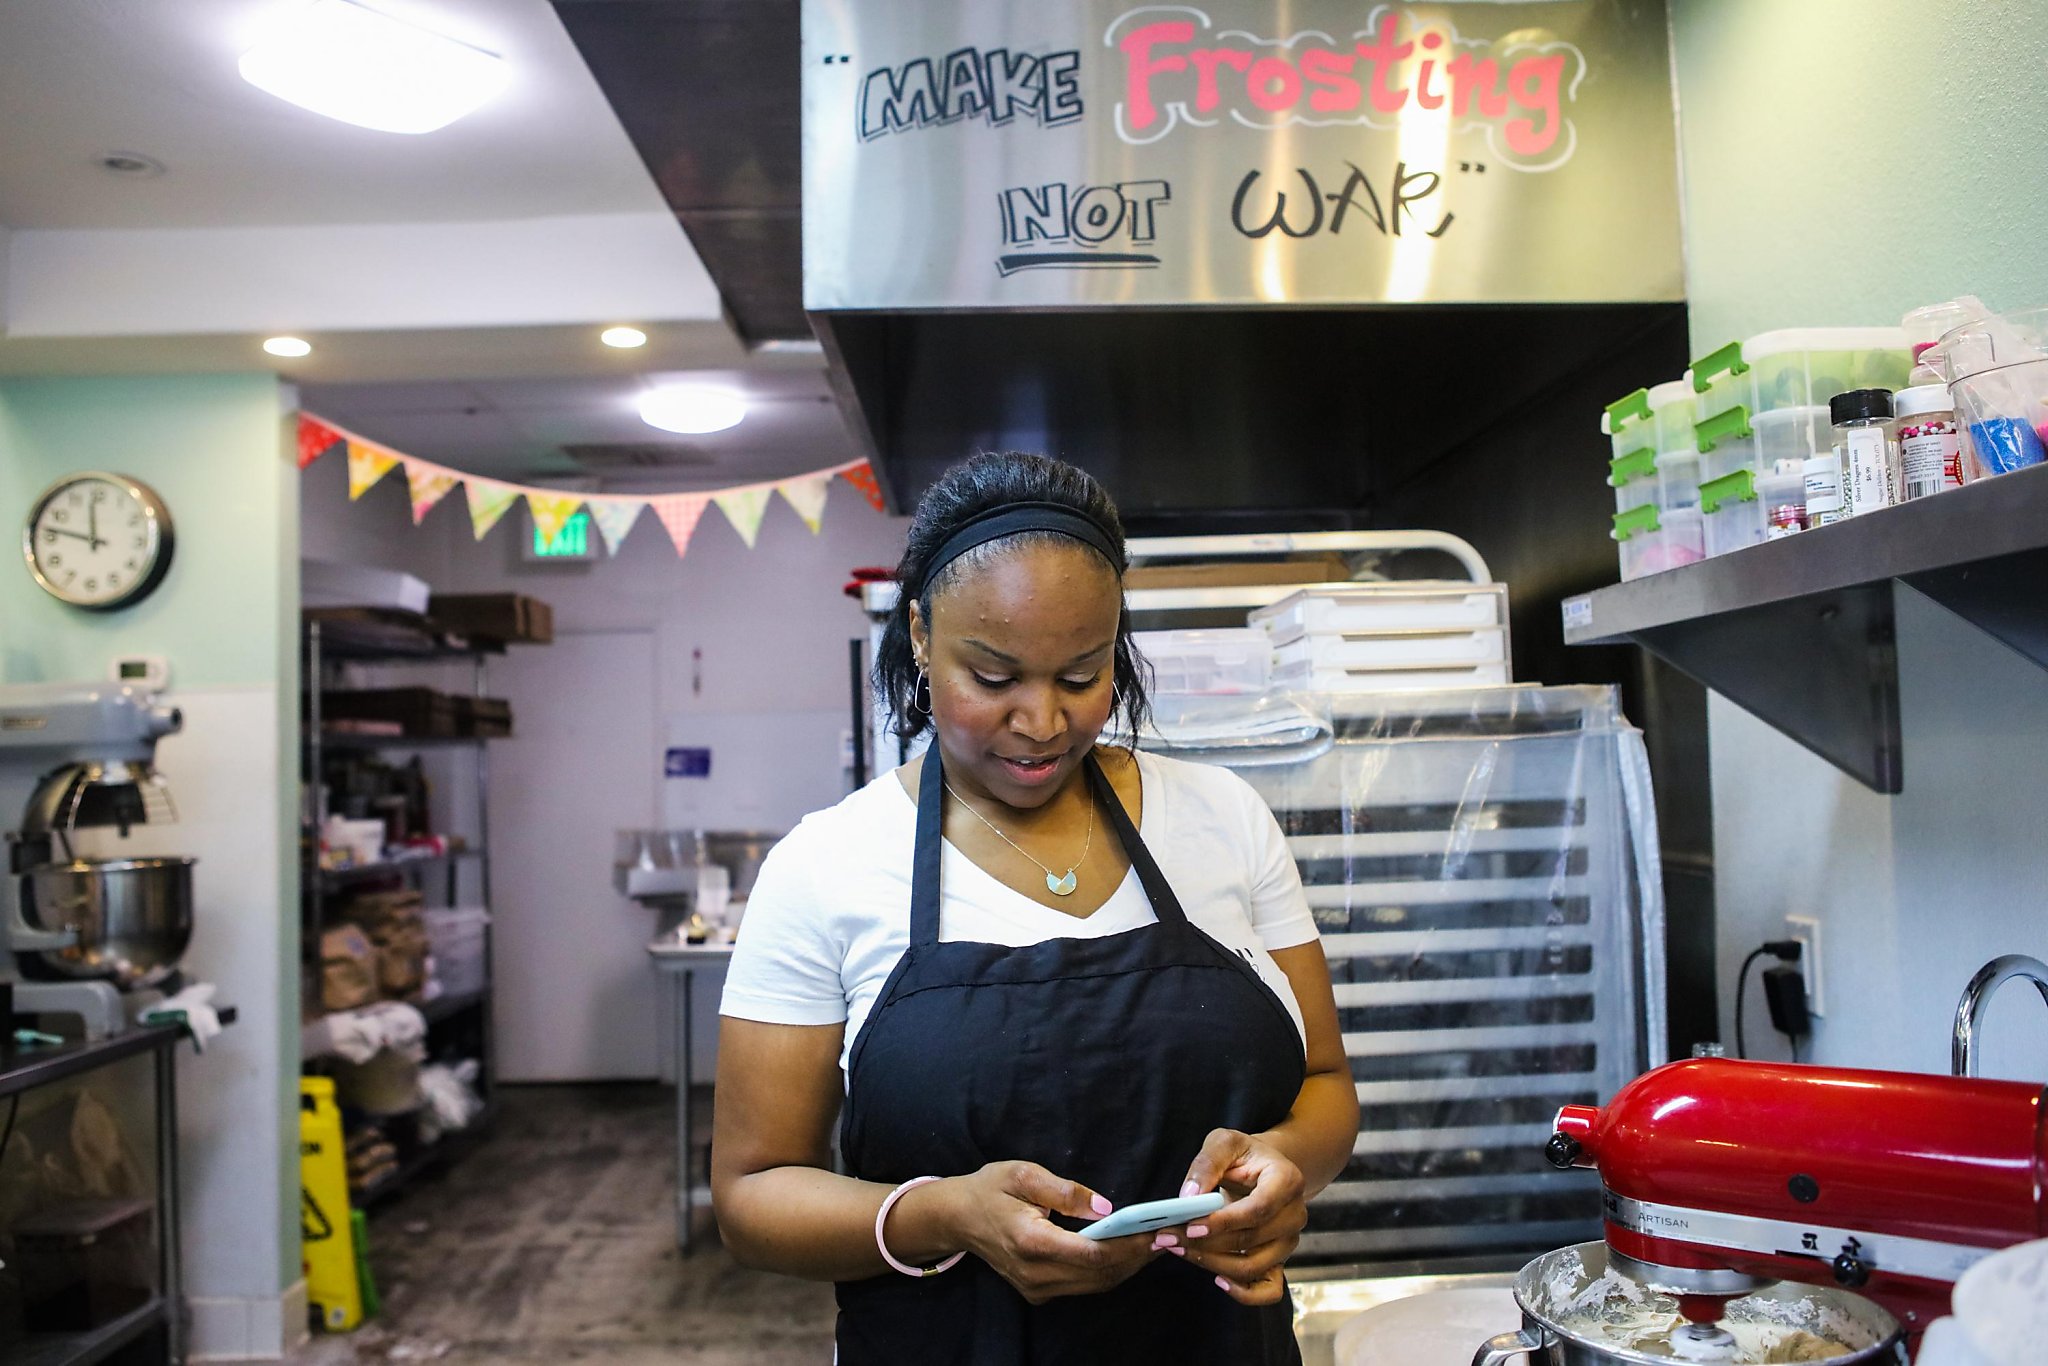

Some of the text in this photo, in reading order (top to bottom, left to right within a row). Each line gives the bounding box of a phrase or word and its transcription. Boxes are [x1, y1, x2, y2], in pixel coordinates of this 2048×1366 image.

[1120, 14, 1565, 155] Frosting
[1000, 180, 1171, 248] NOT
[1638, 1212, 1689, 1229] ARTISAN
